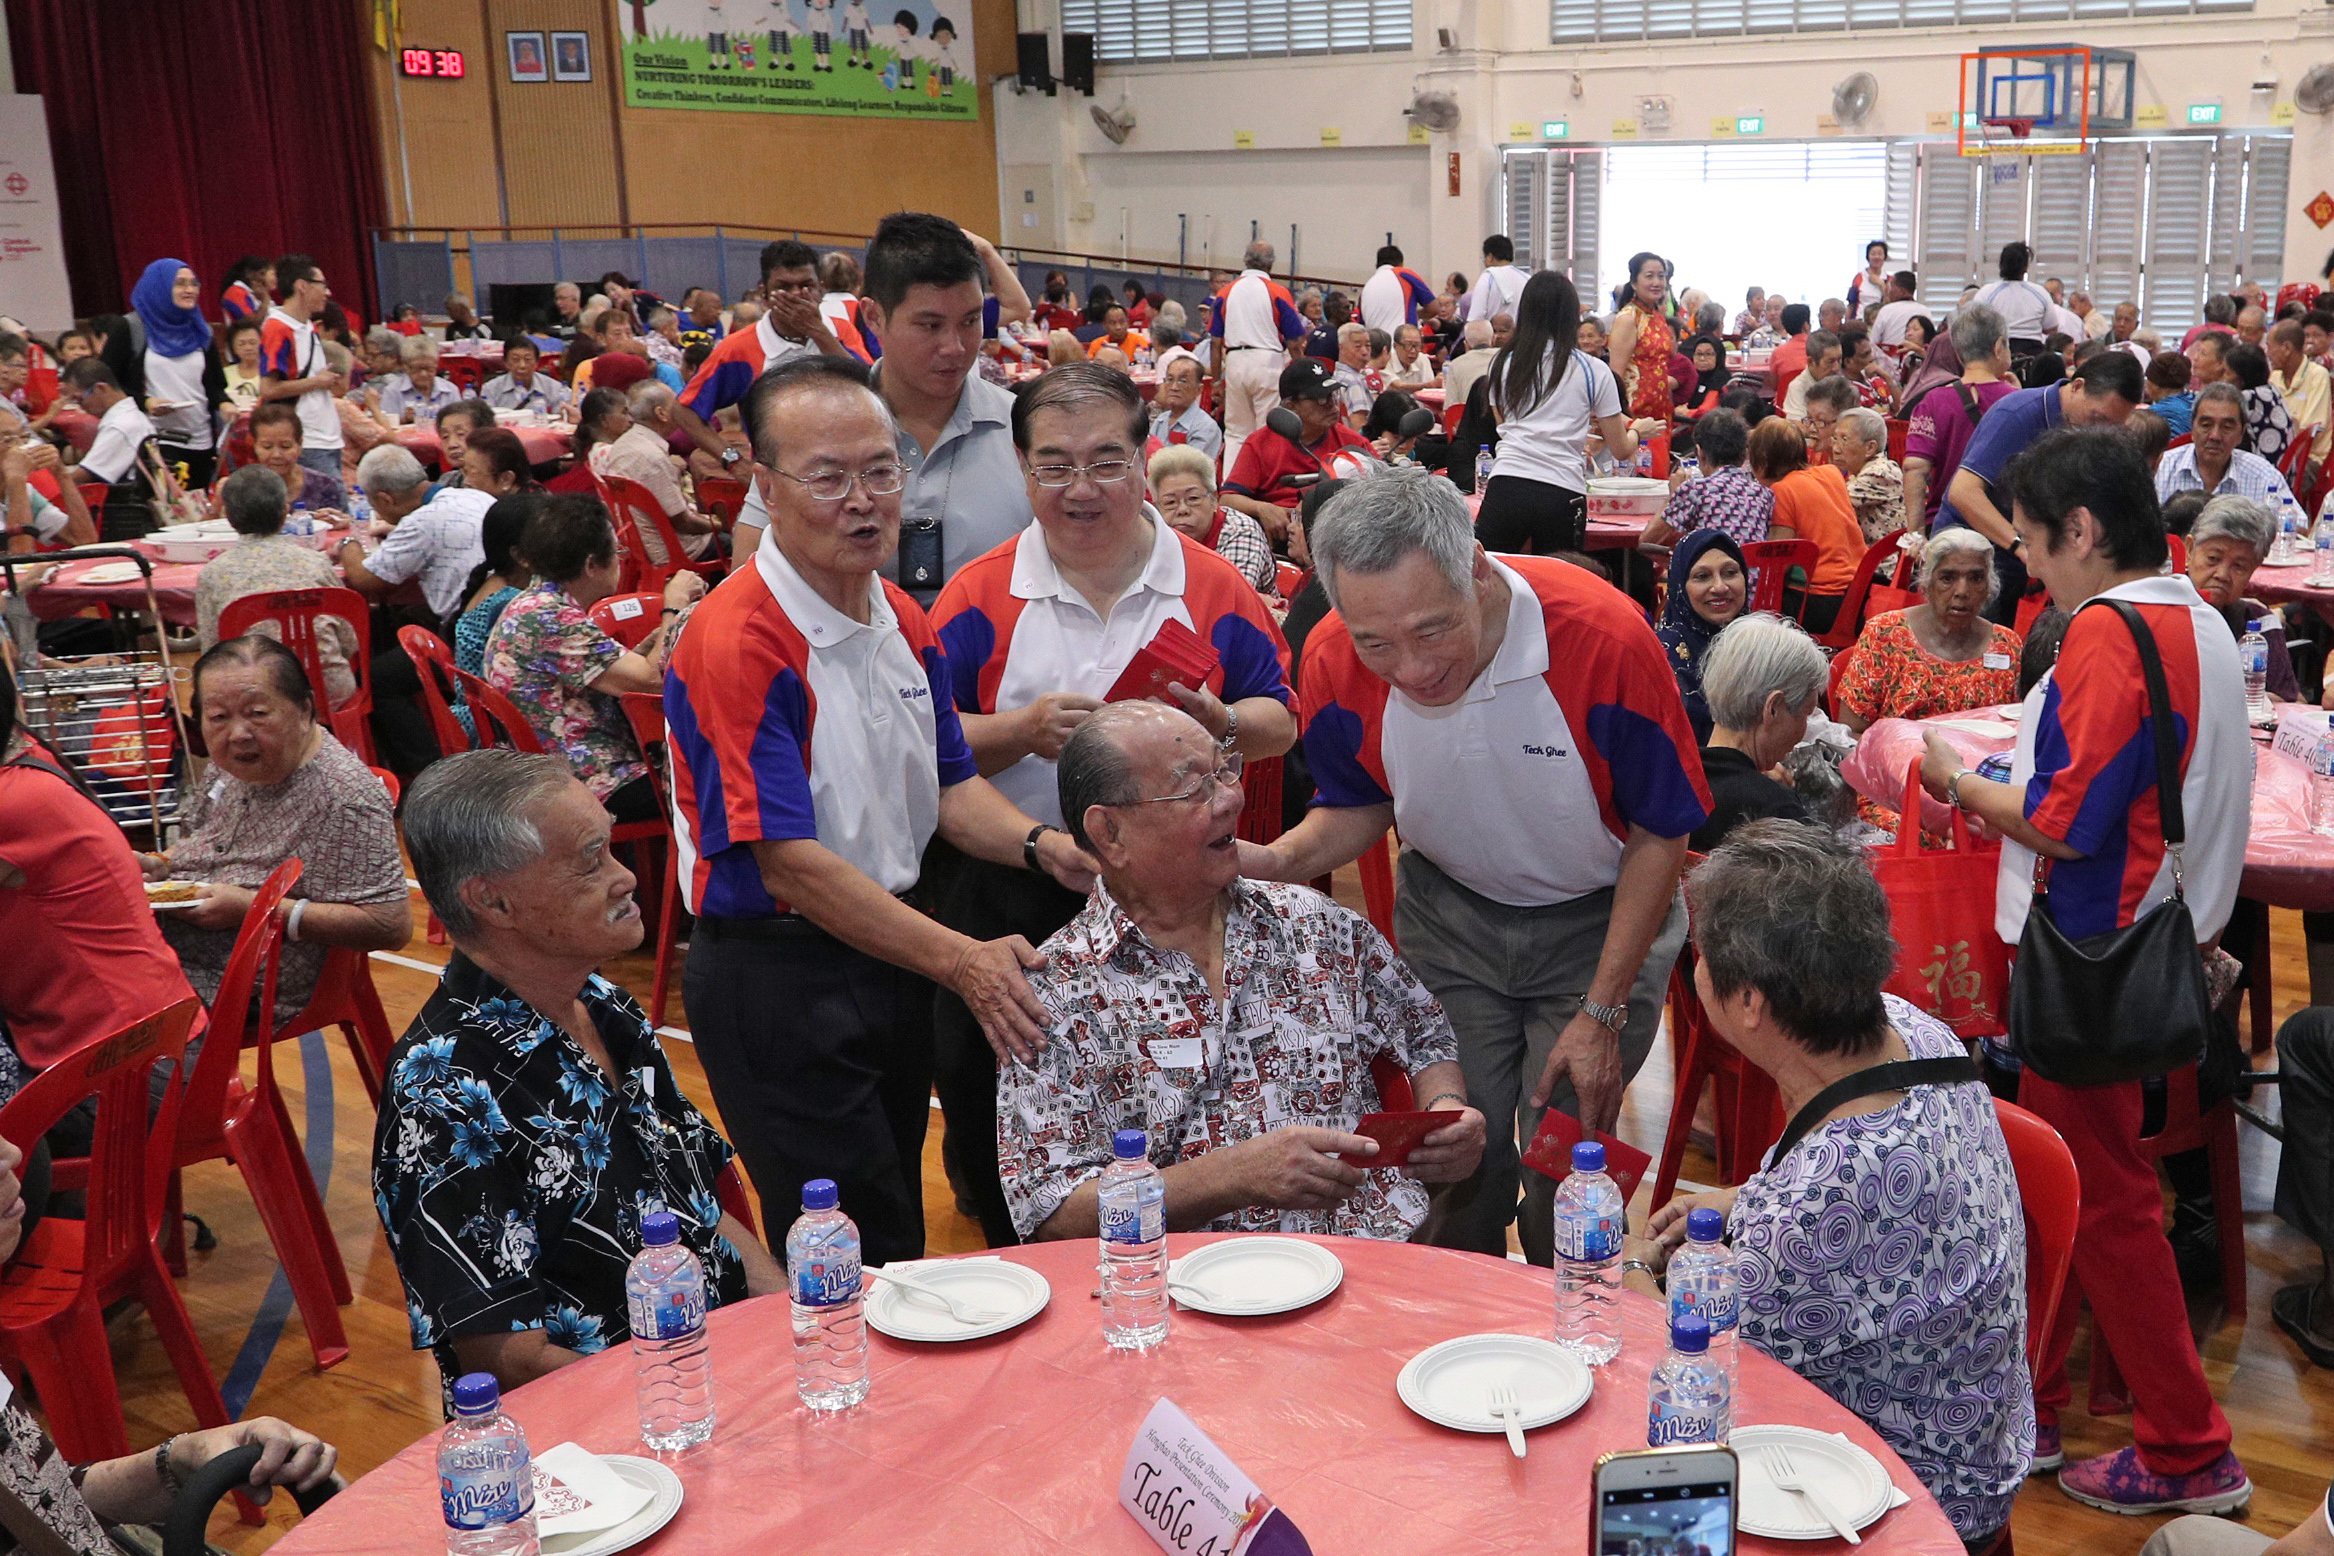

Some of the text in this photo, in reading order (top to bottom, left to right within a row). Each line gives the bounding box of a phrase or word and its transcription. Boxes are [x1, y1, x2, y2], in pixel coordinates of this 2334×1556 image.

[1740, 119, 1761, 132] EXIT
[2192, 107, 2216, 121] EXIT
[1545, 123, 1565, 136] EXIT
[1522, 744, 1567, 757] Teck Ghee
[2278, 731, 2304, 759] Table
[1919, 940, 1981, 1005] 福
[1655, 1415, 1711, 1444] Mizu
[1146, 1428, 1171, 1457] Hongbao
[1169, 1450, 1203, 1490] Presentation
[1201, 1485, 1230, 1519] Ceremony
[1178, 1437, 1230, 1493] Teck Ghee Division
[449, 1481, 511, 1520] Mizu
[1132, 1462, 1196, 1551] Table
